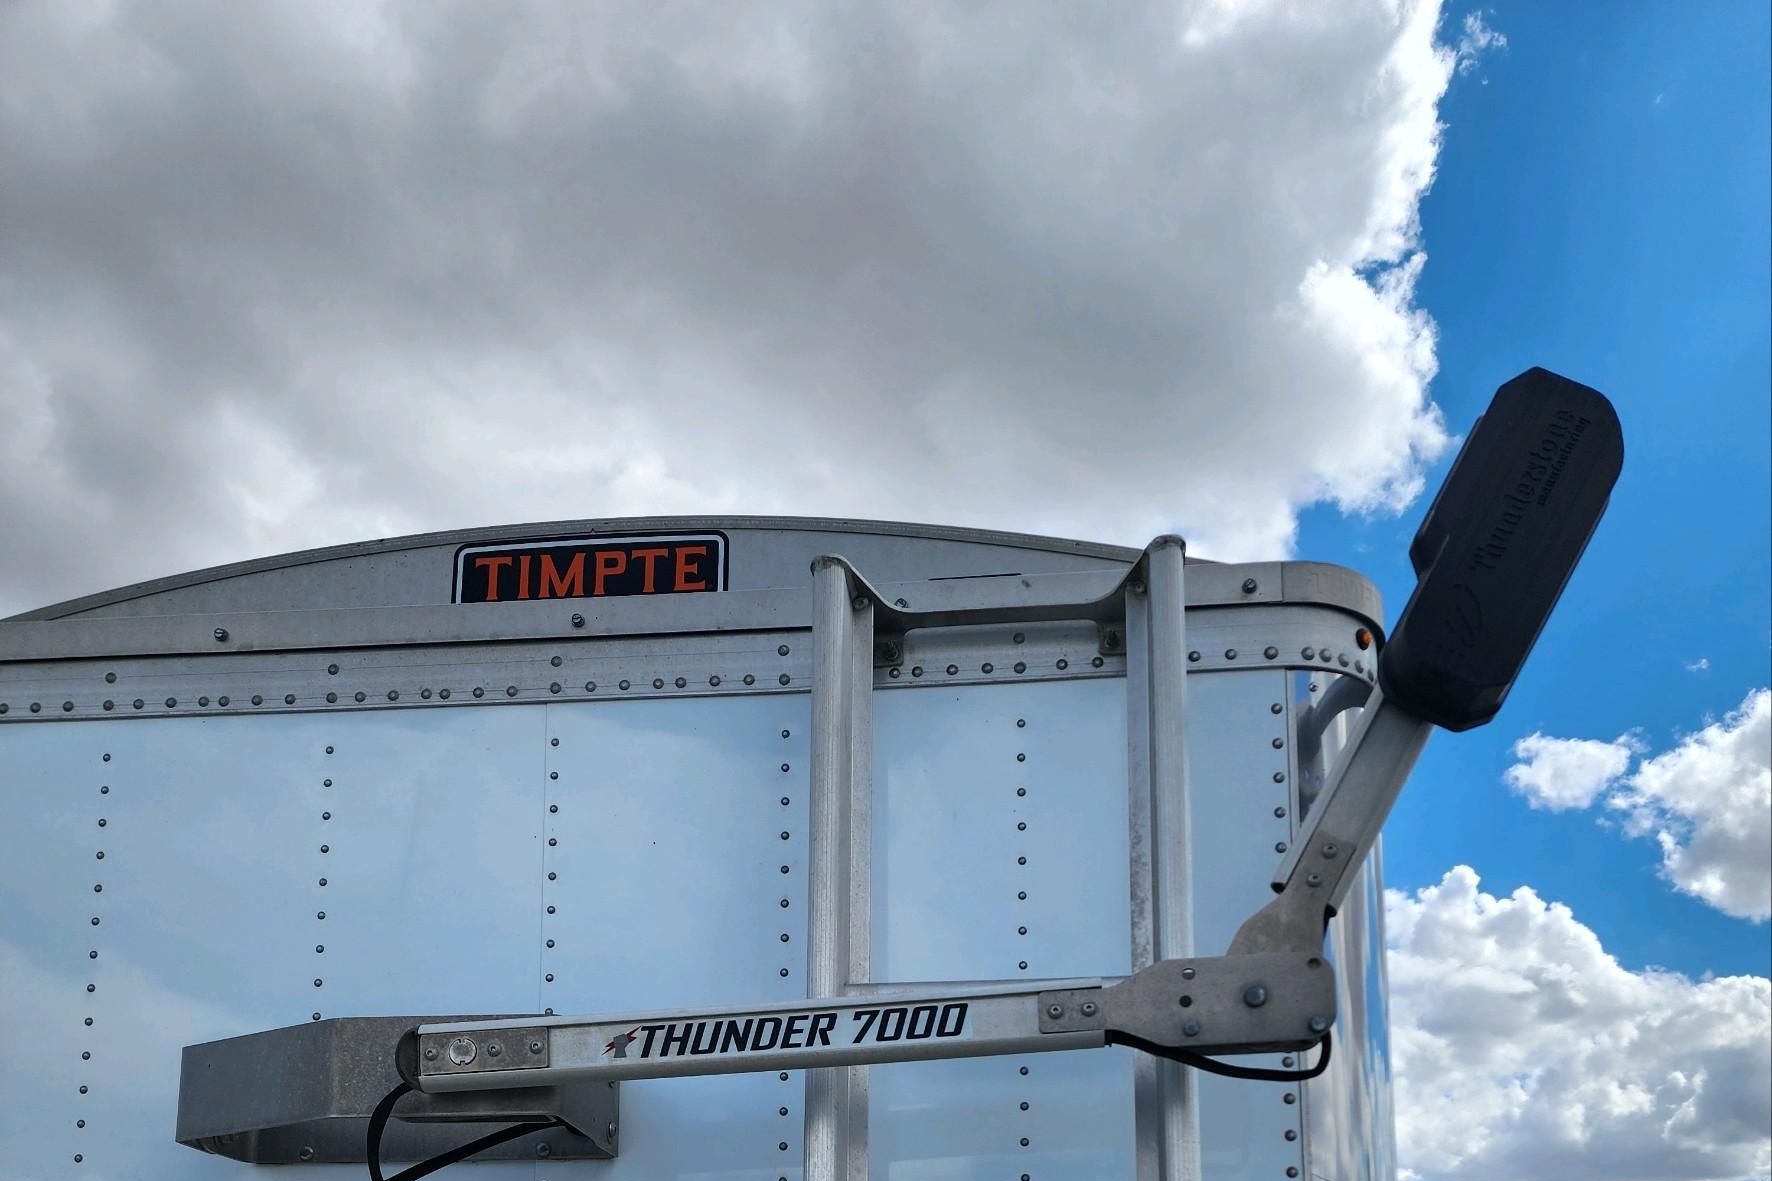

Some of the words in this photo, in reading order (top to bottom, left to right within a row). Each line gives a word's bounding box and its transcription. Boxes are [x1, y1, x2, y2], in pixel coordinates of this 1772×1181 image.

[475, 546, 707, 601] TIMPTE
[640, 1012, 838, 1059] THUNDER
[852, 1002, 969, 1044] 7000
